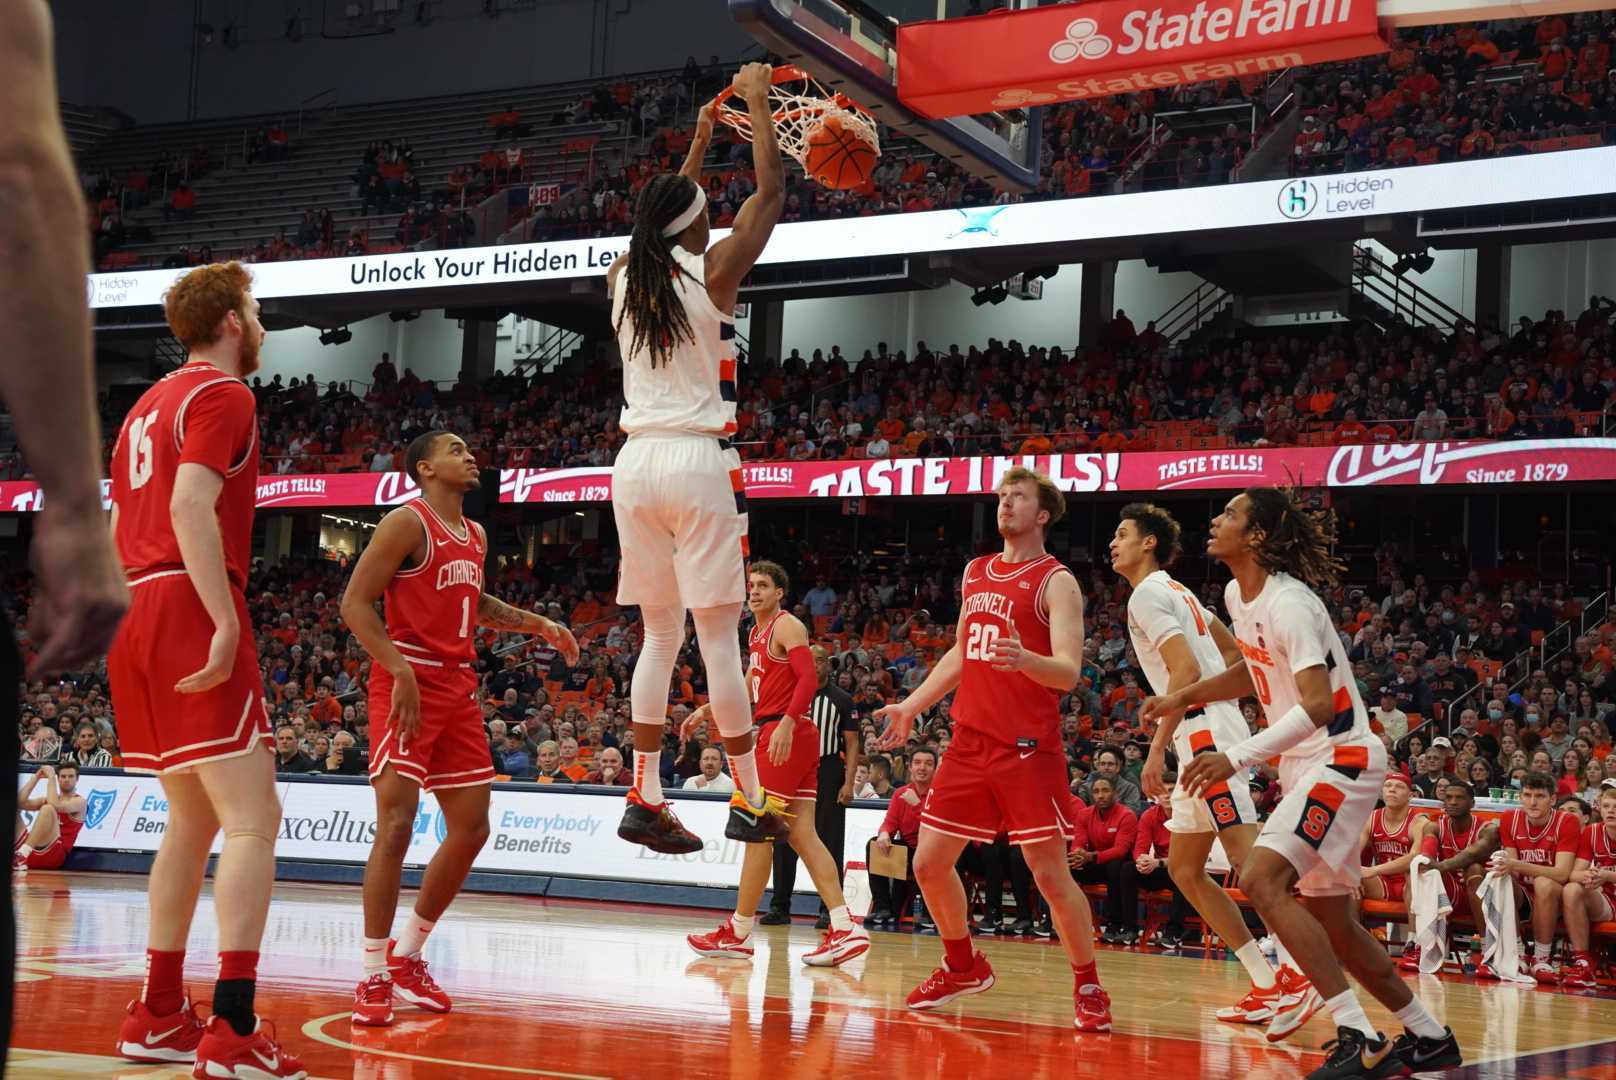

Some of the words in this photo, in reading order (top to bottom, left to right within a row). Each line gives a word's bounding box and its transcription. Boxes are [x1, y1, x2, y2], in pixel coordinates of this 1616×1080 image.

[1325, 177, 1393, 194] Hidden
[1325, 195, 1375, 212] Level
[350, 258, 425, 284] Unlock
[434, 256, 484, 278] Your
[493, 248, 577, 274] Hidden
[99, 277, 138, 288] Hidden
[98, 290, 127, 303] Level
[751, 466, 793, 483] TELLS!
[809, 457, 951, 497] TASTE
[1158, 456, 1207, 480] TASTE
[1210, 454, 1264, 471] TELLS!
[1466, 466, 1516, 484] Since
[1523, 463, 1569, 482] 1879
[256, 480, 289, 499] TASTE
[291, 479, 326, 493] TELLS!
[543, 486, 575, 502] Since
[580, 486, 609, 501] 1879
[459, 596, 470, 638] 1
[966, 622, 1001, 662] 20
[1212, 796, 1237, 824] S
[500, 810, 601, 836] Everybody
[1302, 805, 1330, 840] S
[494, 834, 572, 855] Benefits
